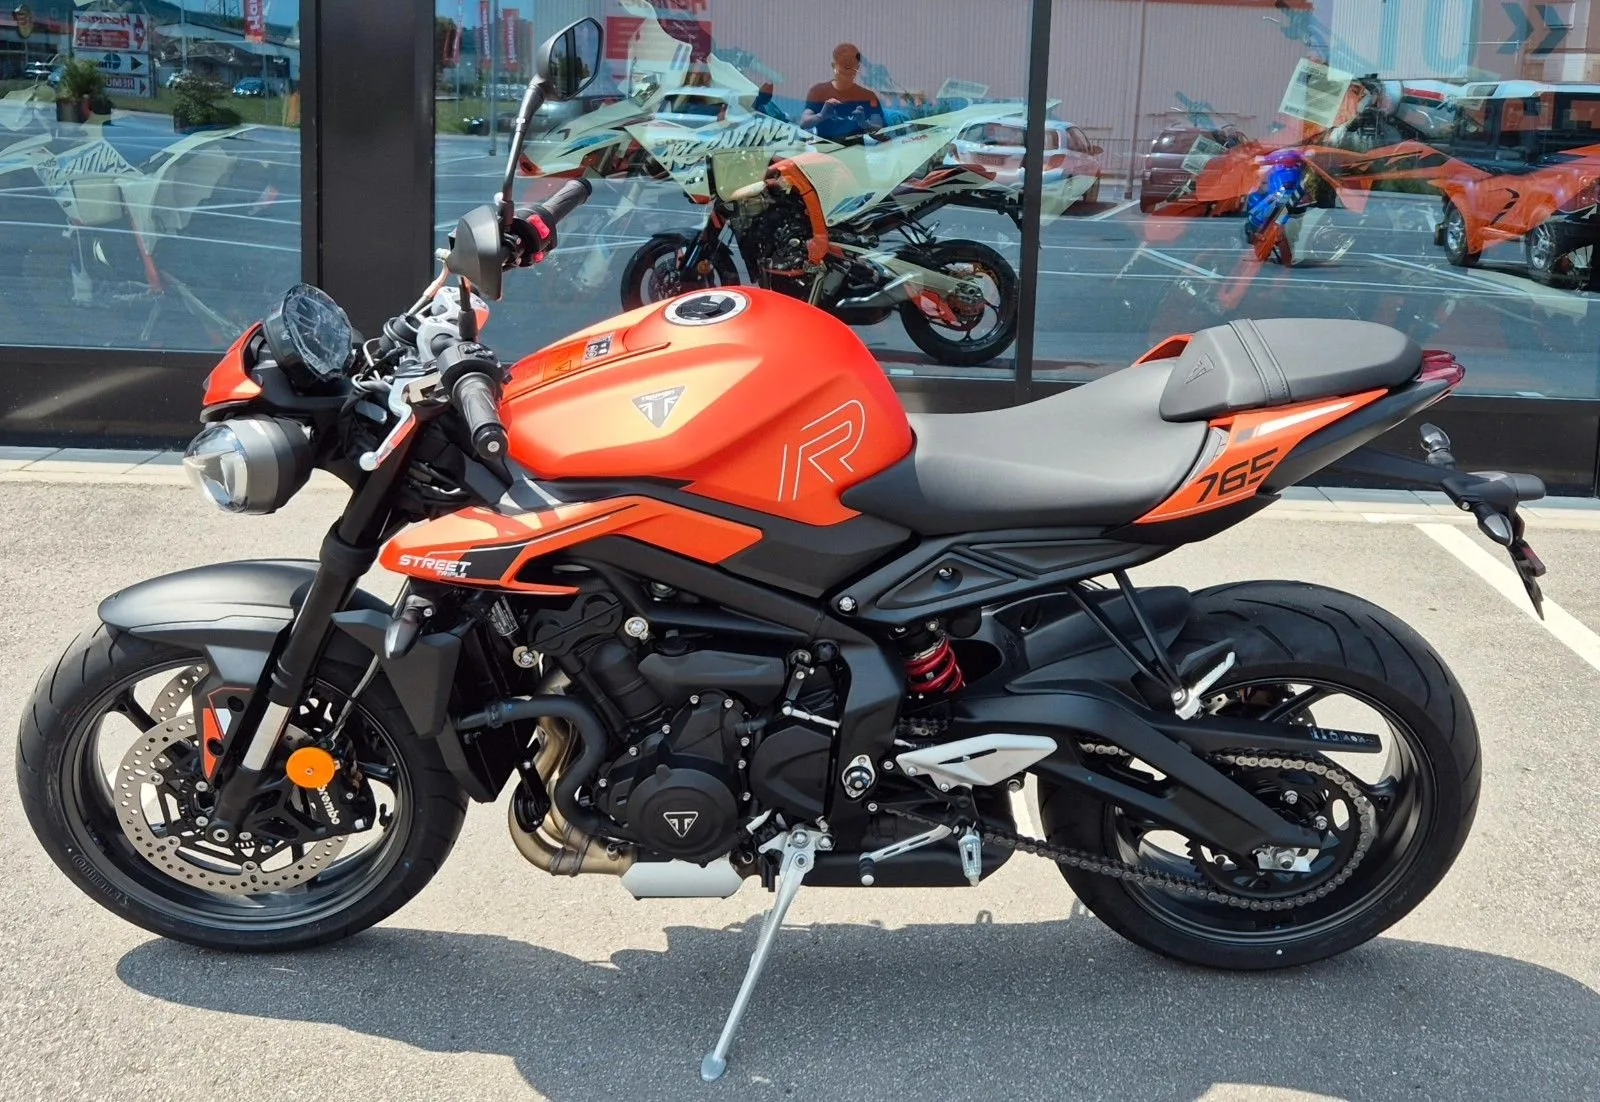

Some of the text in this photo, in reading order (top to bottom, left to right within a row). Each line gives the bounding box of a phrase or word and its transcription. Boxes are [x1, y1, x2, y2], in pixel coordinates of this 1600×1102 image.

[778, 399, 865, 502] R
[1196, 447, 1279, 505] 765
[399, 554, 472, 573] STREET
[436, 570, 467, 579] TRIPLE
[317, 783, 340, 825] brembo
